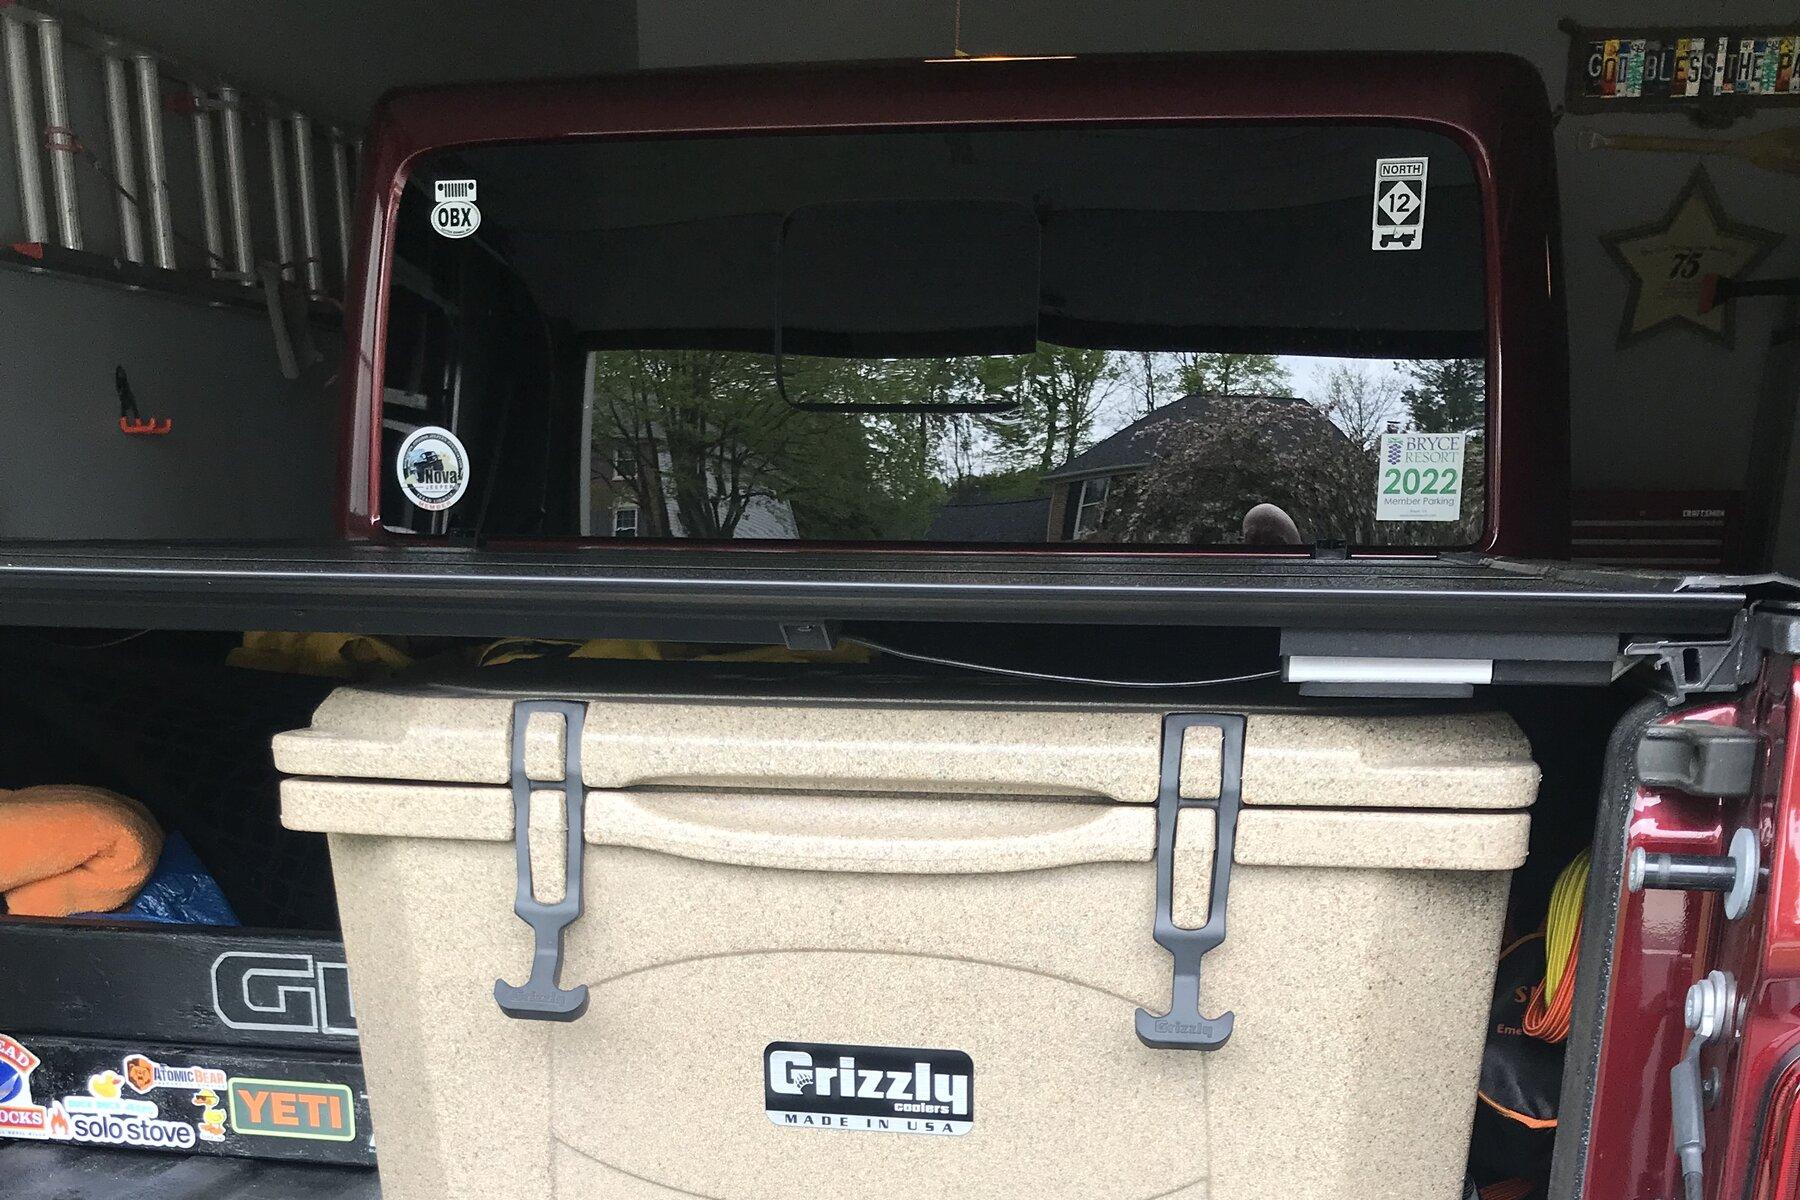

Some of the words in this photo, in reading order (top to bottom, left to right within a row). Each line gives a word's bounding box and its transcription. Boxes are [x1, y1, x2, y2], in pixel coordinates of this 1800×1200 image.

[1645, 52, 1716, 83] BLESS
[1726, 52, 1763, 83] THE
[1382, 164, 1421, 175] NORTH
[1389, 193, 1411, 213] 12
[438, 207, 472, 228] OBX
[1406, 436, 1460, 451] BRYCE
[1404, 451, 1459, 464] RESORT
[1383, 468, 1458, 495] 2022
[1384, 497, 1421, 506] Member
[1423, 497, 1455, 507] Parking
[1154, 1020, 1214, 1038] Grizzly
[769, 1050, 968, 1116] Grizzly
[238, 1089, 342, 1129] YETI
[894, 1102, 950, 1114] coolers
[75, 1116, 123, 1138] solo
[127, 1119, 191, 1144] stove
[785, 1113, 849, 1127] MADE
[866, 1119, 890, 1129] IN
[907, 1121, 954, 1133] USA
